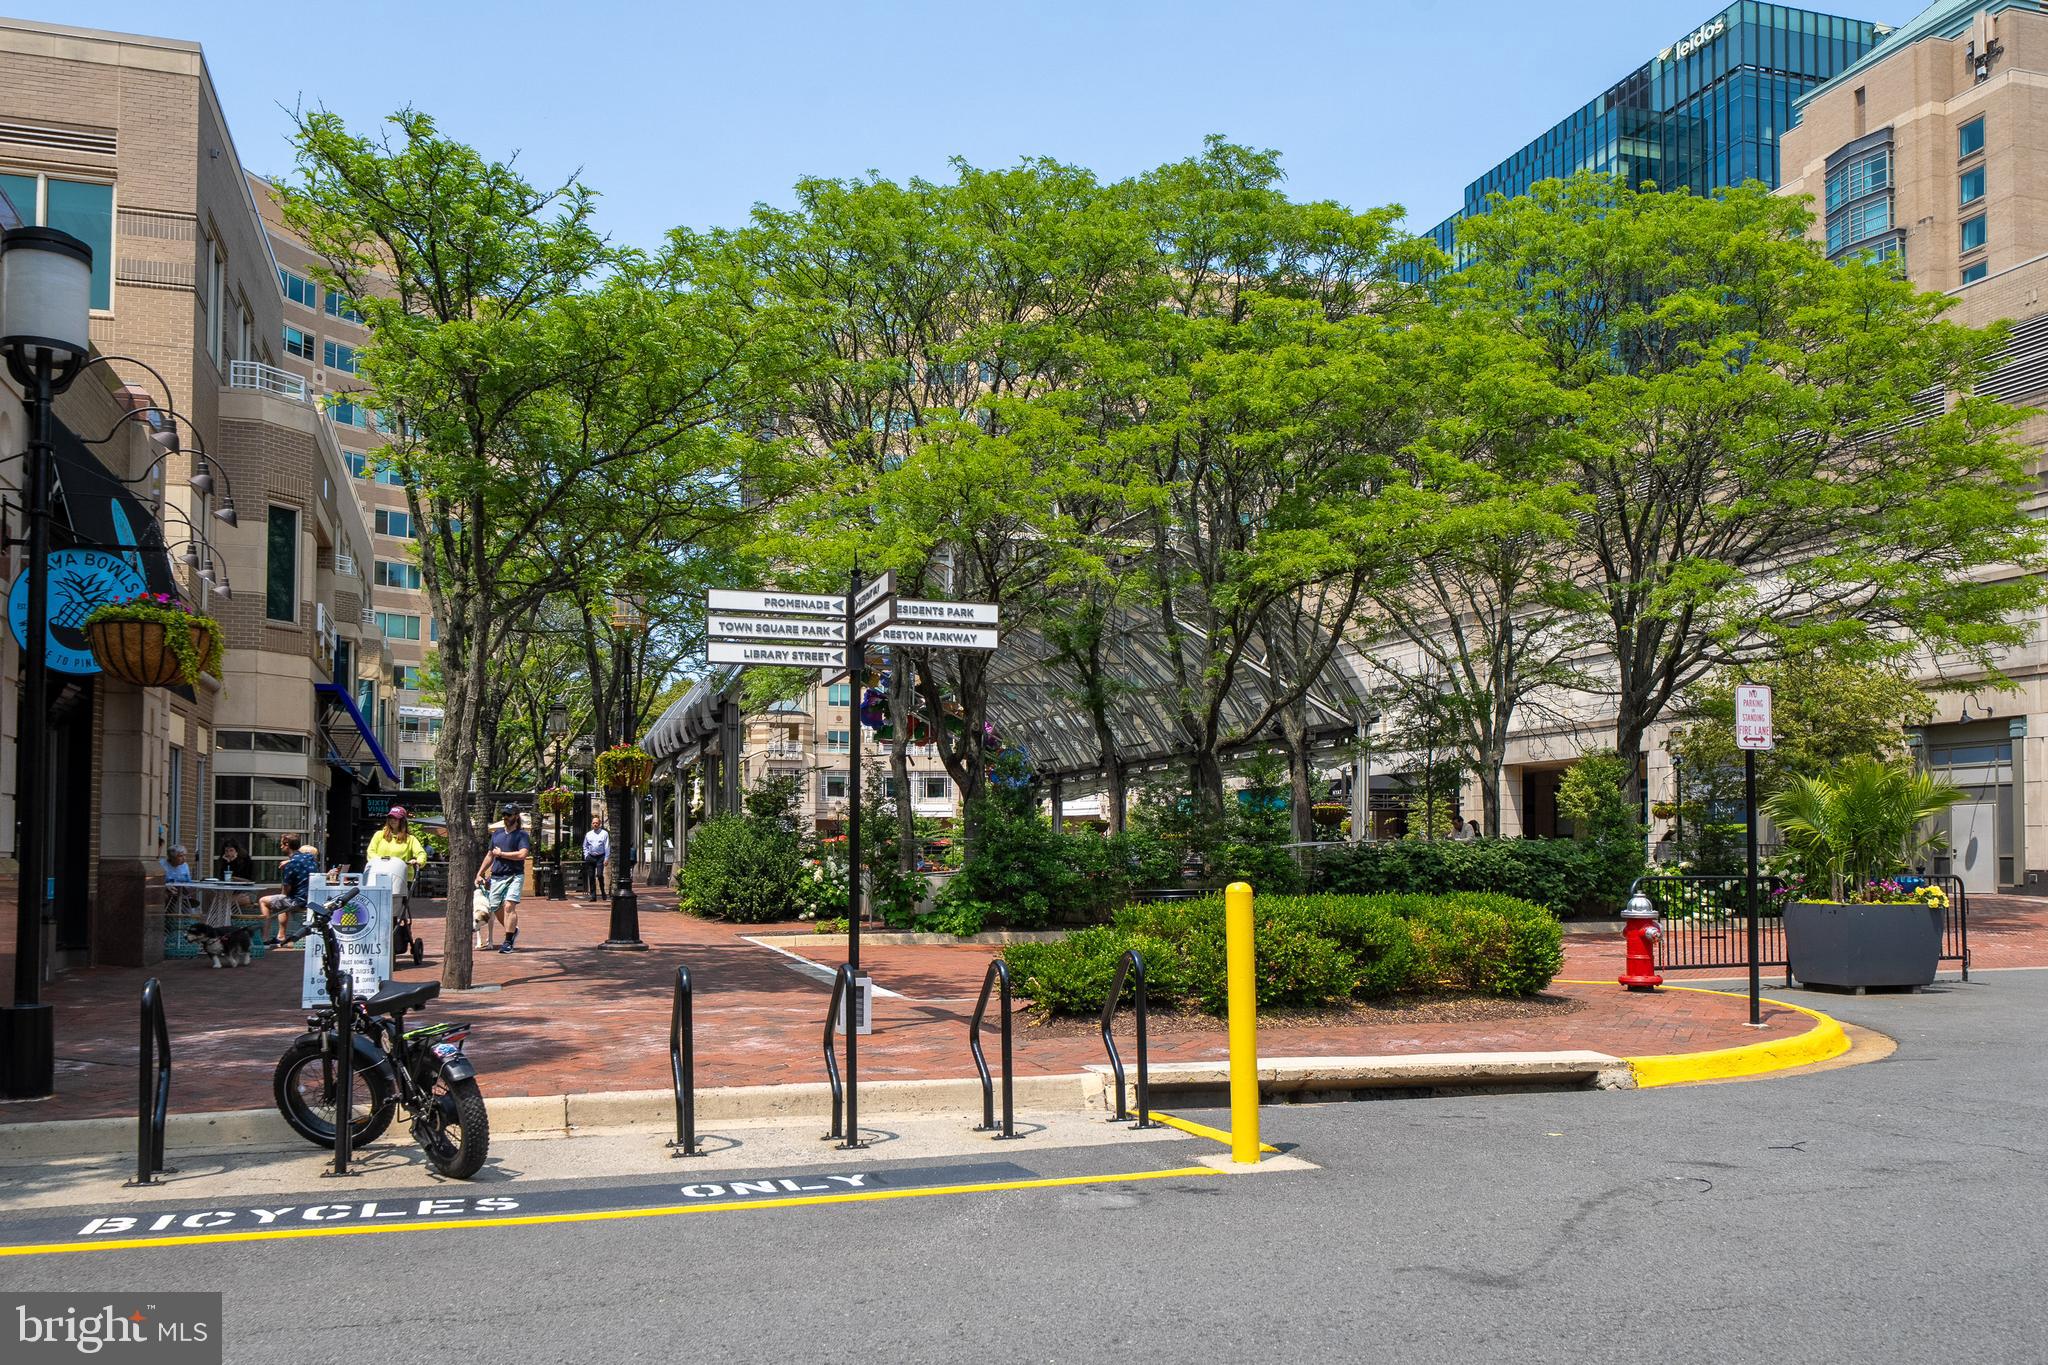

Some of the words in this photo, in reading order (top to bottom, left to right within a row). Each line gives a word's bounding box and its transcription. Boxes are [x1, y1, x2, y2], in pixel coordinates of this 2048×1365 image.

[1676, 15, 1725, 60] leidos
[84, 553, 140, 594] BOWLS
[764, 597, 830, 610] PROMENADE
[896, 603, 945, 618] ESIDENTS
[947, 607, 974, 618] PARK
[719, 621, 751, 633] TOWN
[755, 623, 799, 635] SQUARE
[801, 625, 830, 637] PARK
[883, 630, 923, 641] RESTON
[926, 632, 977, 644] PARKWAY
[743, 649, 790, 661] LIBRARY
[792, 651, 830, 663] STREET
[1748, 690, 1757, 698] NO
[1743, 699, 1763, 707] PARKING
[1742, 713, 1765, 722] STANDING
[1739, 725, 1752, 735] FIRE
[1754, 726, 1770, 736] LANE
[348, 943, 381, 955] BOWLS
[681, 1174, 865, 1197] ONLY
[77, 1197, 520, 1235] BICYCLES
